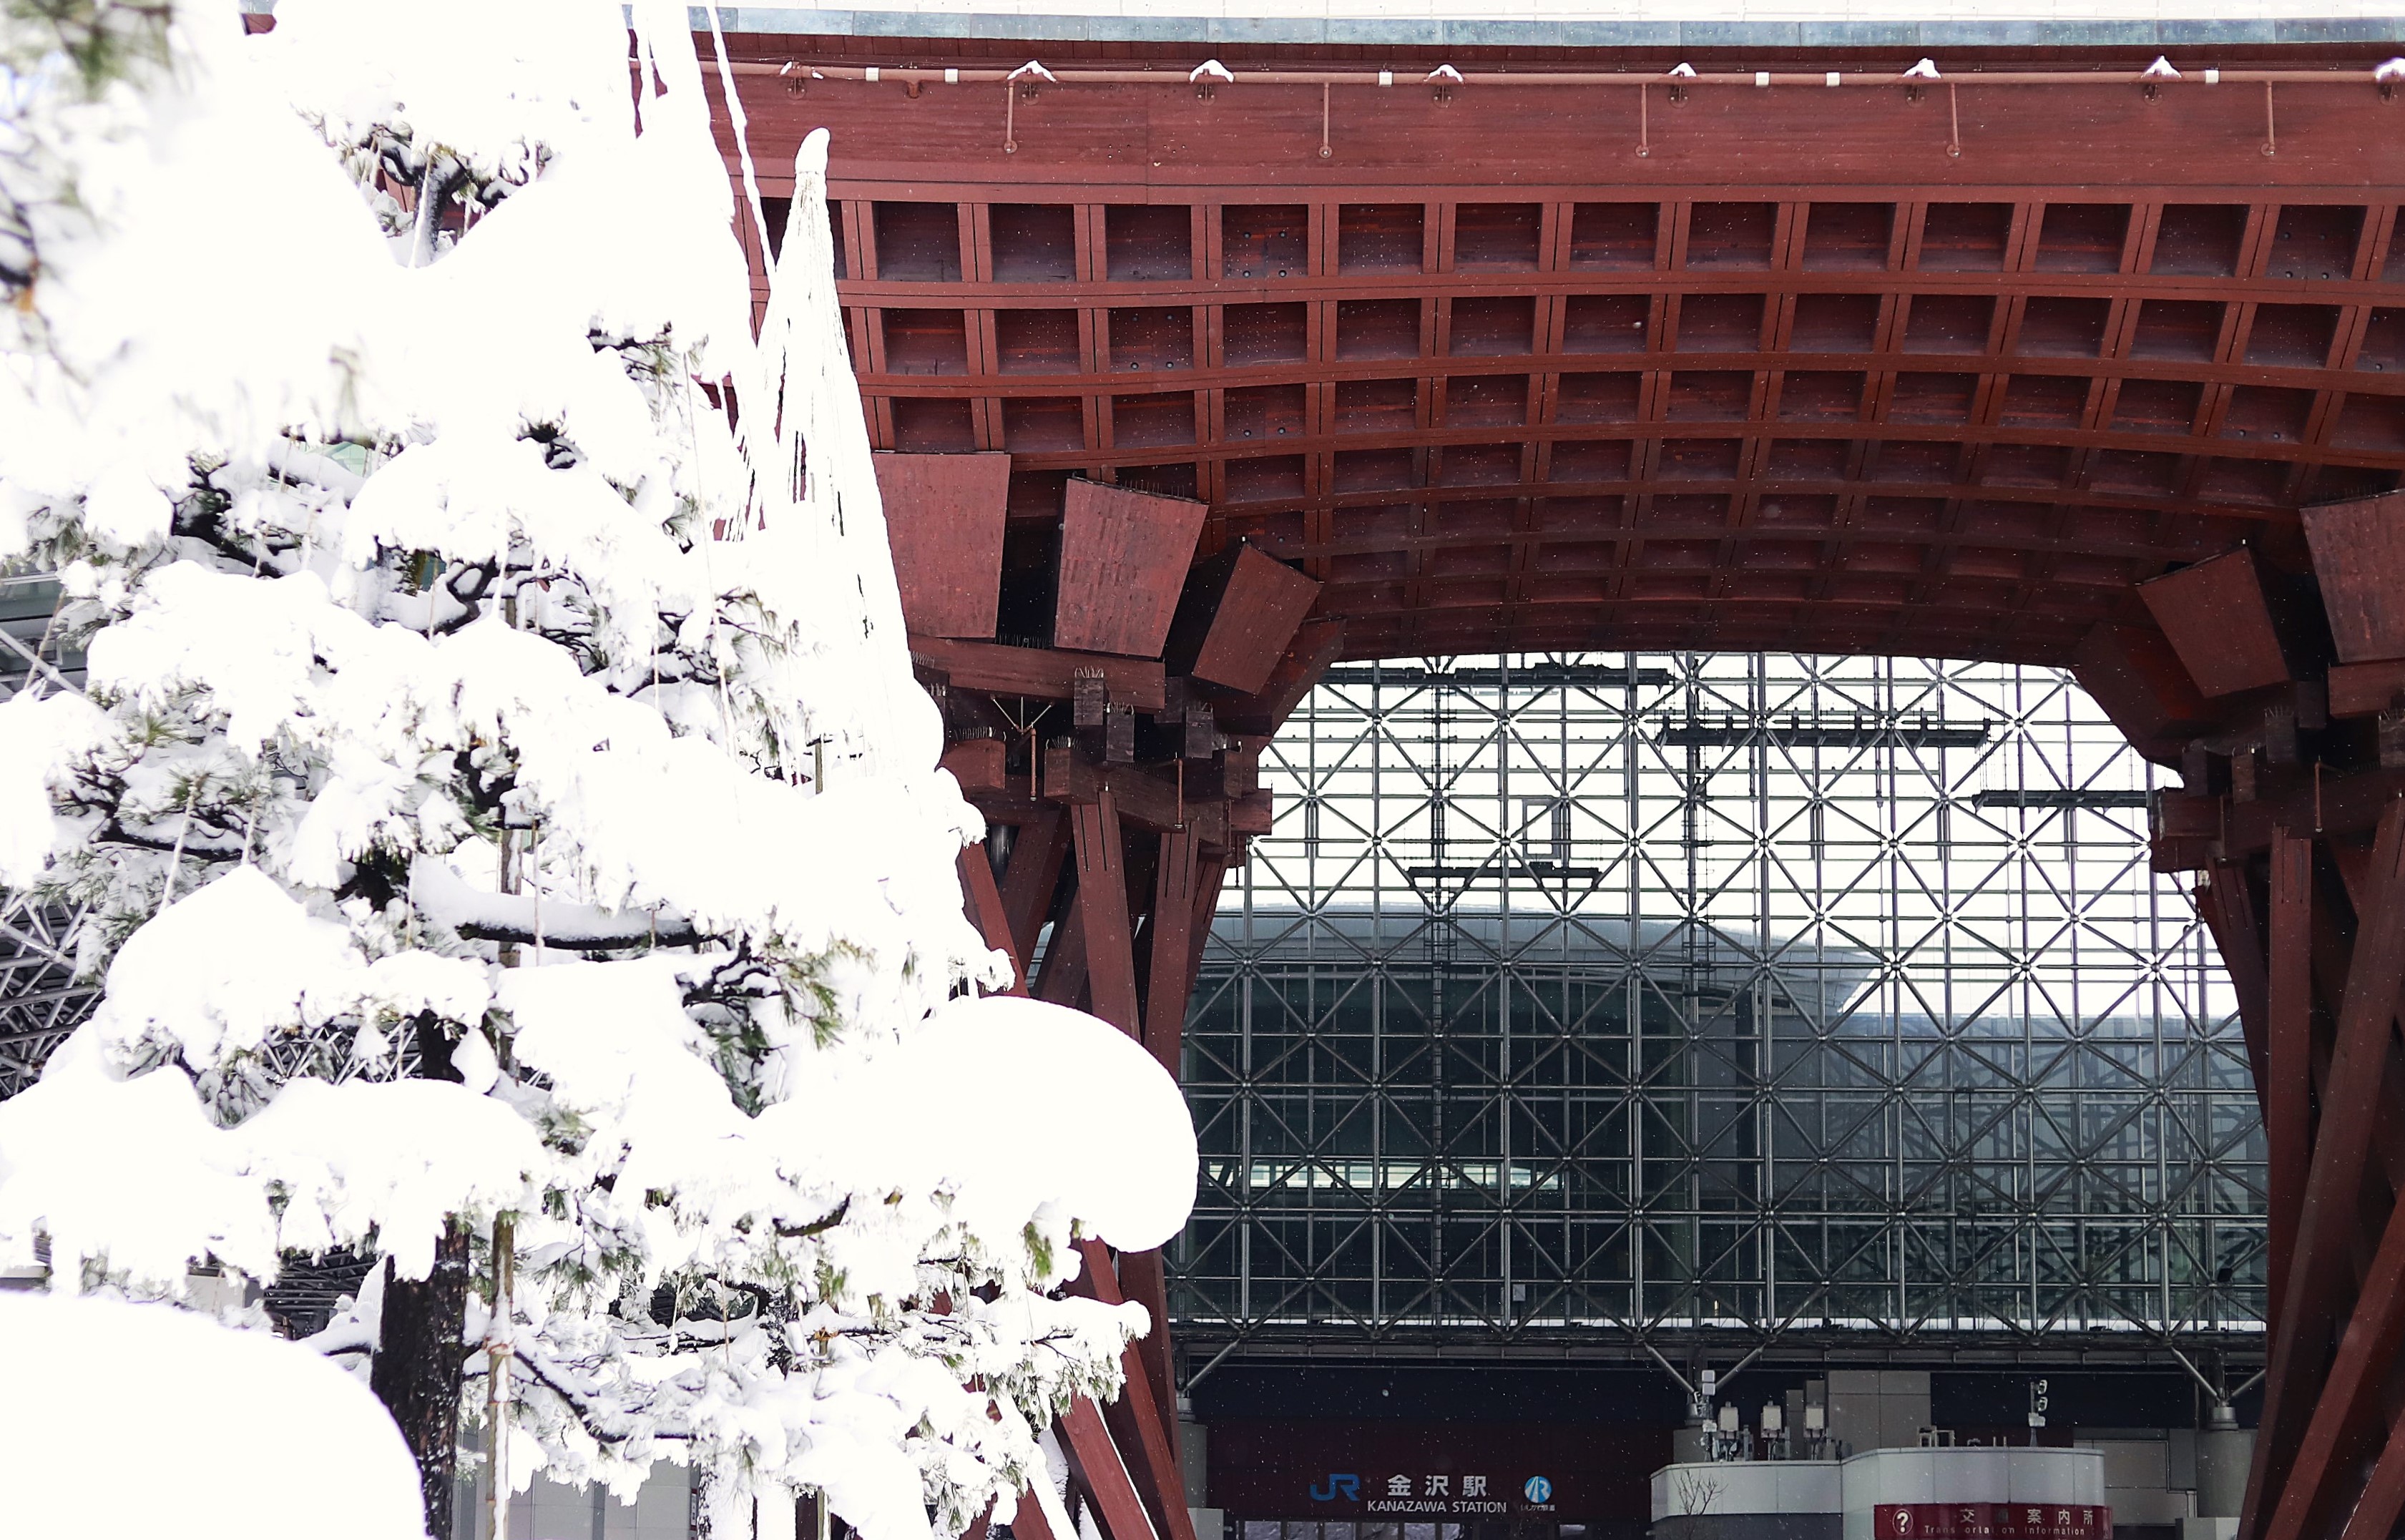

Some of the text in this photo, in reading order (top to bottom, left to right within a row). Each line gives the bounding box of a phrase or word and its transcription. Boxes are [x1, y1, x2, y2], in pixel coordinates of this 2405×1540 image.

[1310, 1473, 1361, 1501] JR
[1388, 1474, 1487, 1497] 金沢駅
[1368, 1500, 1507, 1513] KANAZAWA STATION
[1960, 1509, 2093, 1525] 交案内所
[1924, 1525, 2015, 1534] Transortaton
[2024, 1526, 2085, 1535] Information
